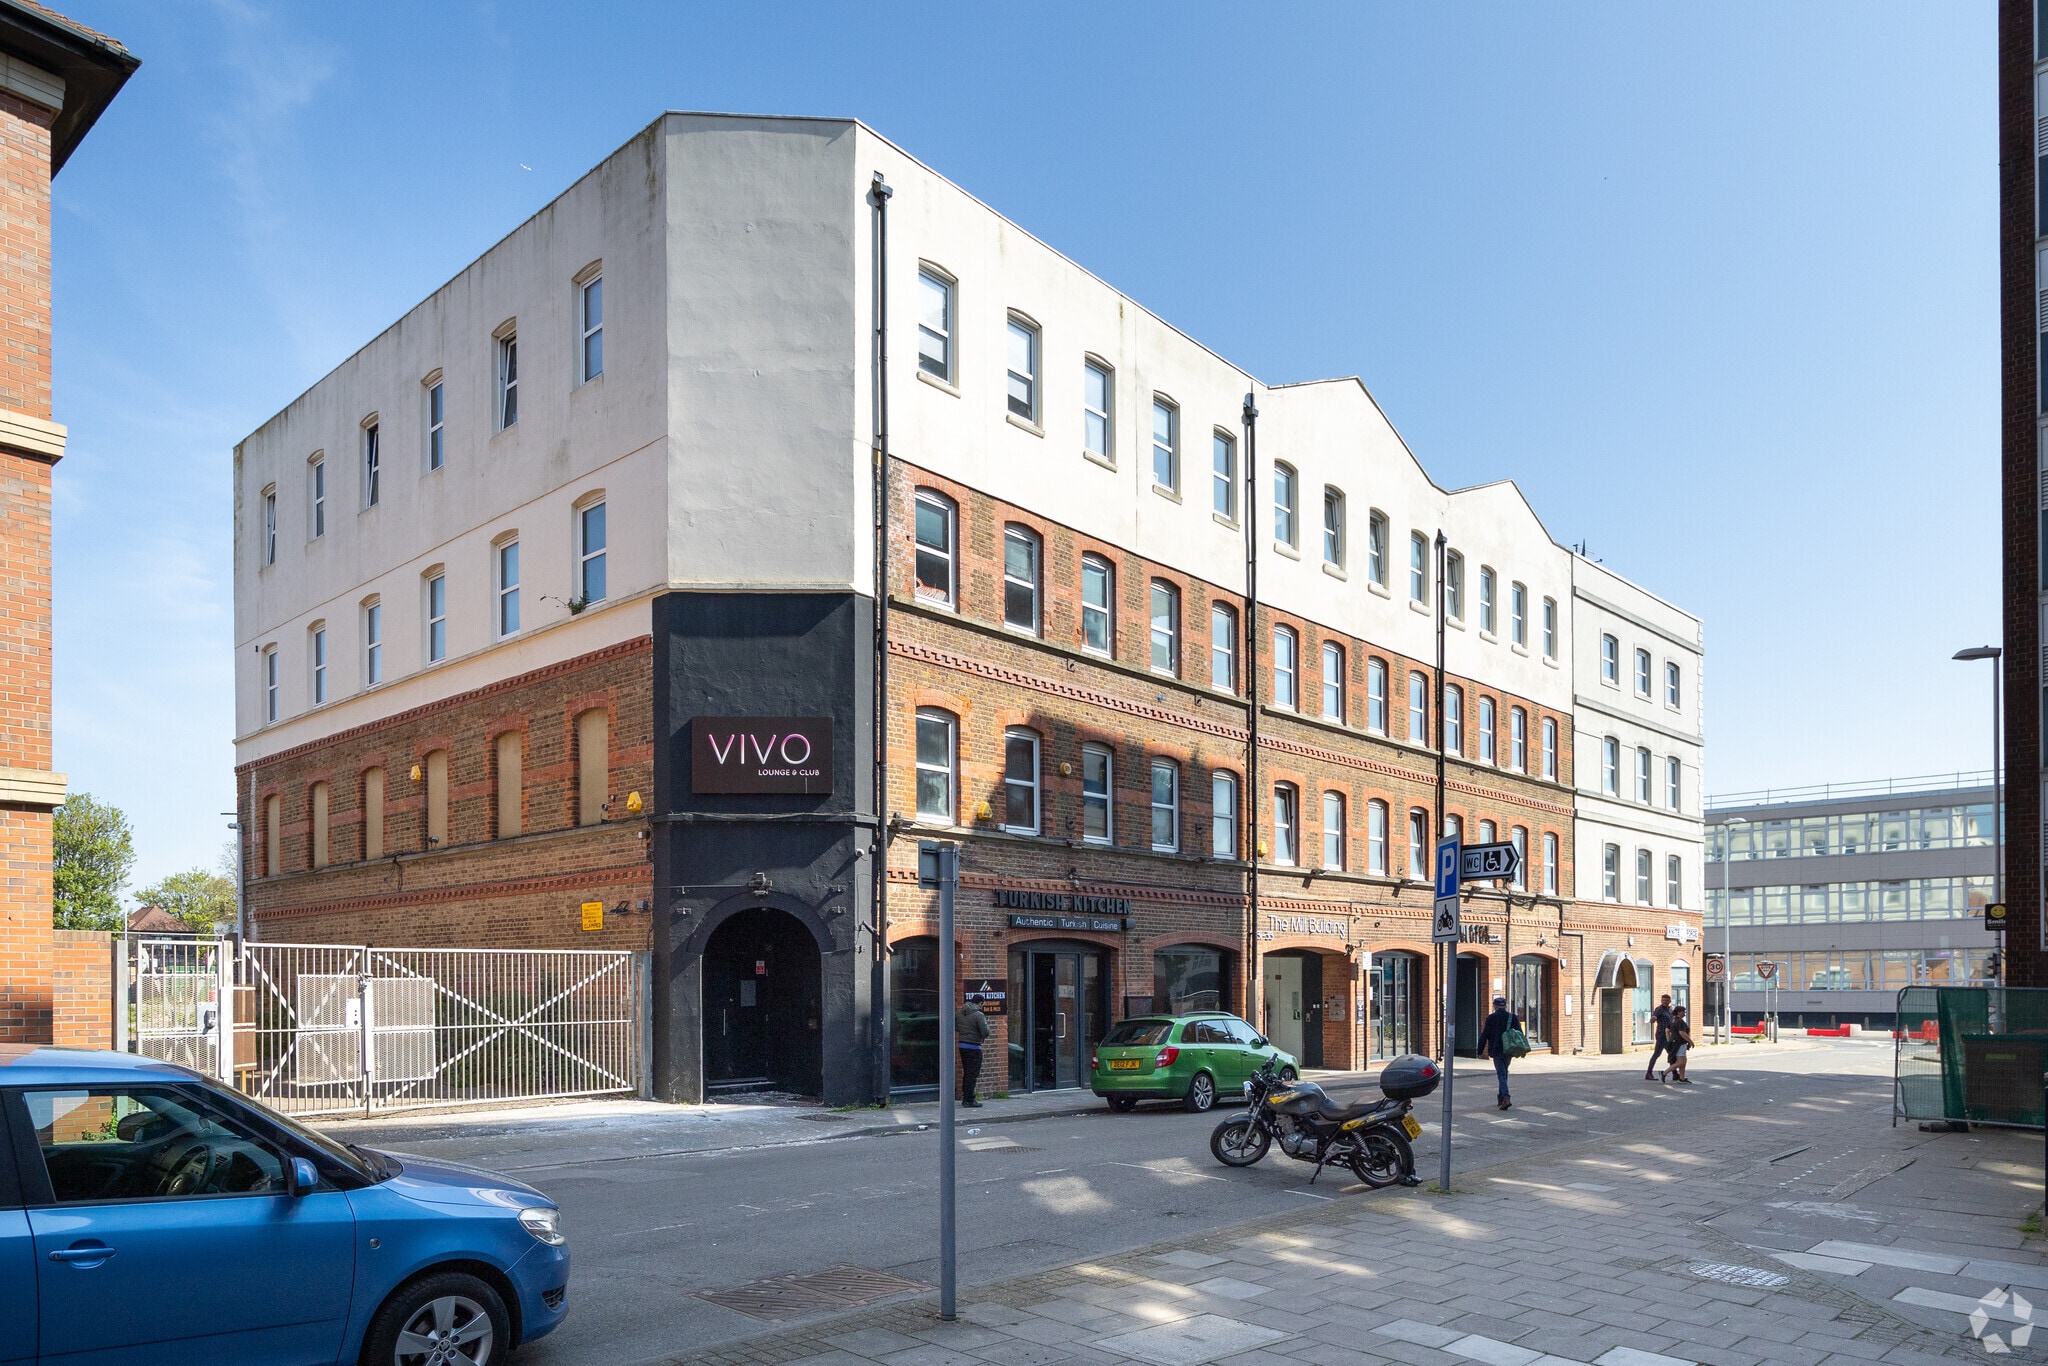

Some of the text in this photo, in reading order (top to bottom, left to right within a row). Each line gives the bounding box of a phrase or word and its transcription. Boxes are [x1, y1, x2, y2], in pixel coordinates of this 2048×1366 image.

[708, 733, 811, 765] VIVO
[1441, 847, 1455, 894] P
[1466, 857, 1479, 869] WC
[994, 889, 1132, 914] TURKISH KITCHEN
[1015, 916, 1053, 927] Authentic
[1093, 921, 1118, 930] Cuisine
[1267, 915, 1346, 939] The Mill Building
